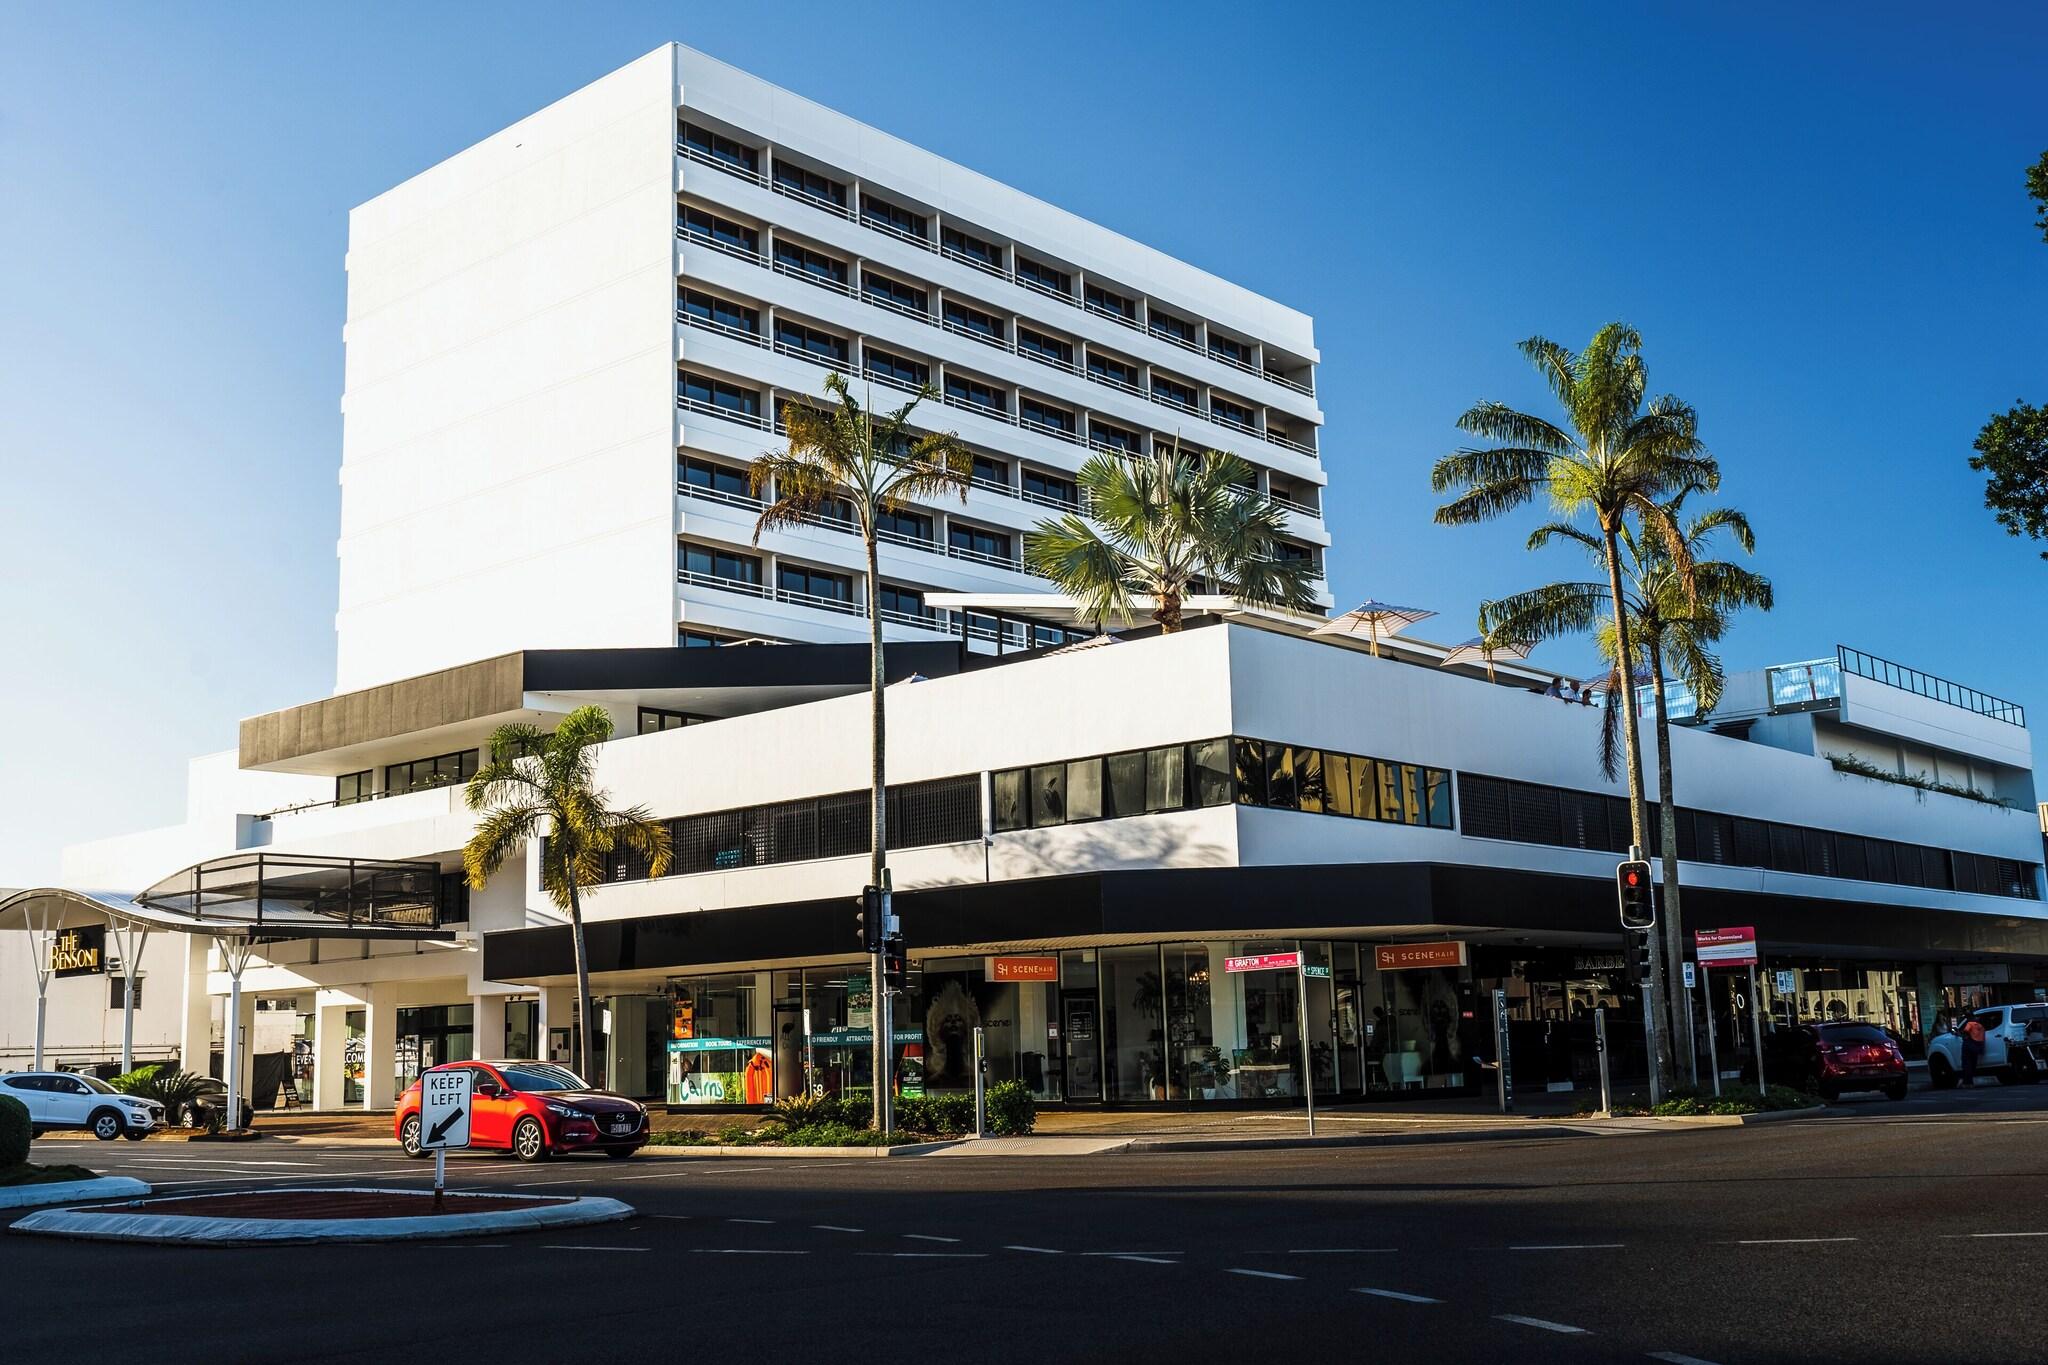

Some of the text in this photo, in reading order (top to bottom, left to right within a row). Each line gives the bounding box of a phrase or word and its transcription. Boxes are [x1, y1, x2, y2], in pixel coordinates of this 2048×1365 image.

[60, 931, 78, 951] THE
[50, 945, 97, 970] BENSON
[1234, 958, 1260, 967] GRAFTON
[431, 1077, 464, 1090] KEEP
[431, 1093, 462, 1106] LEFT
